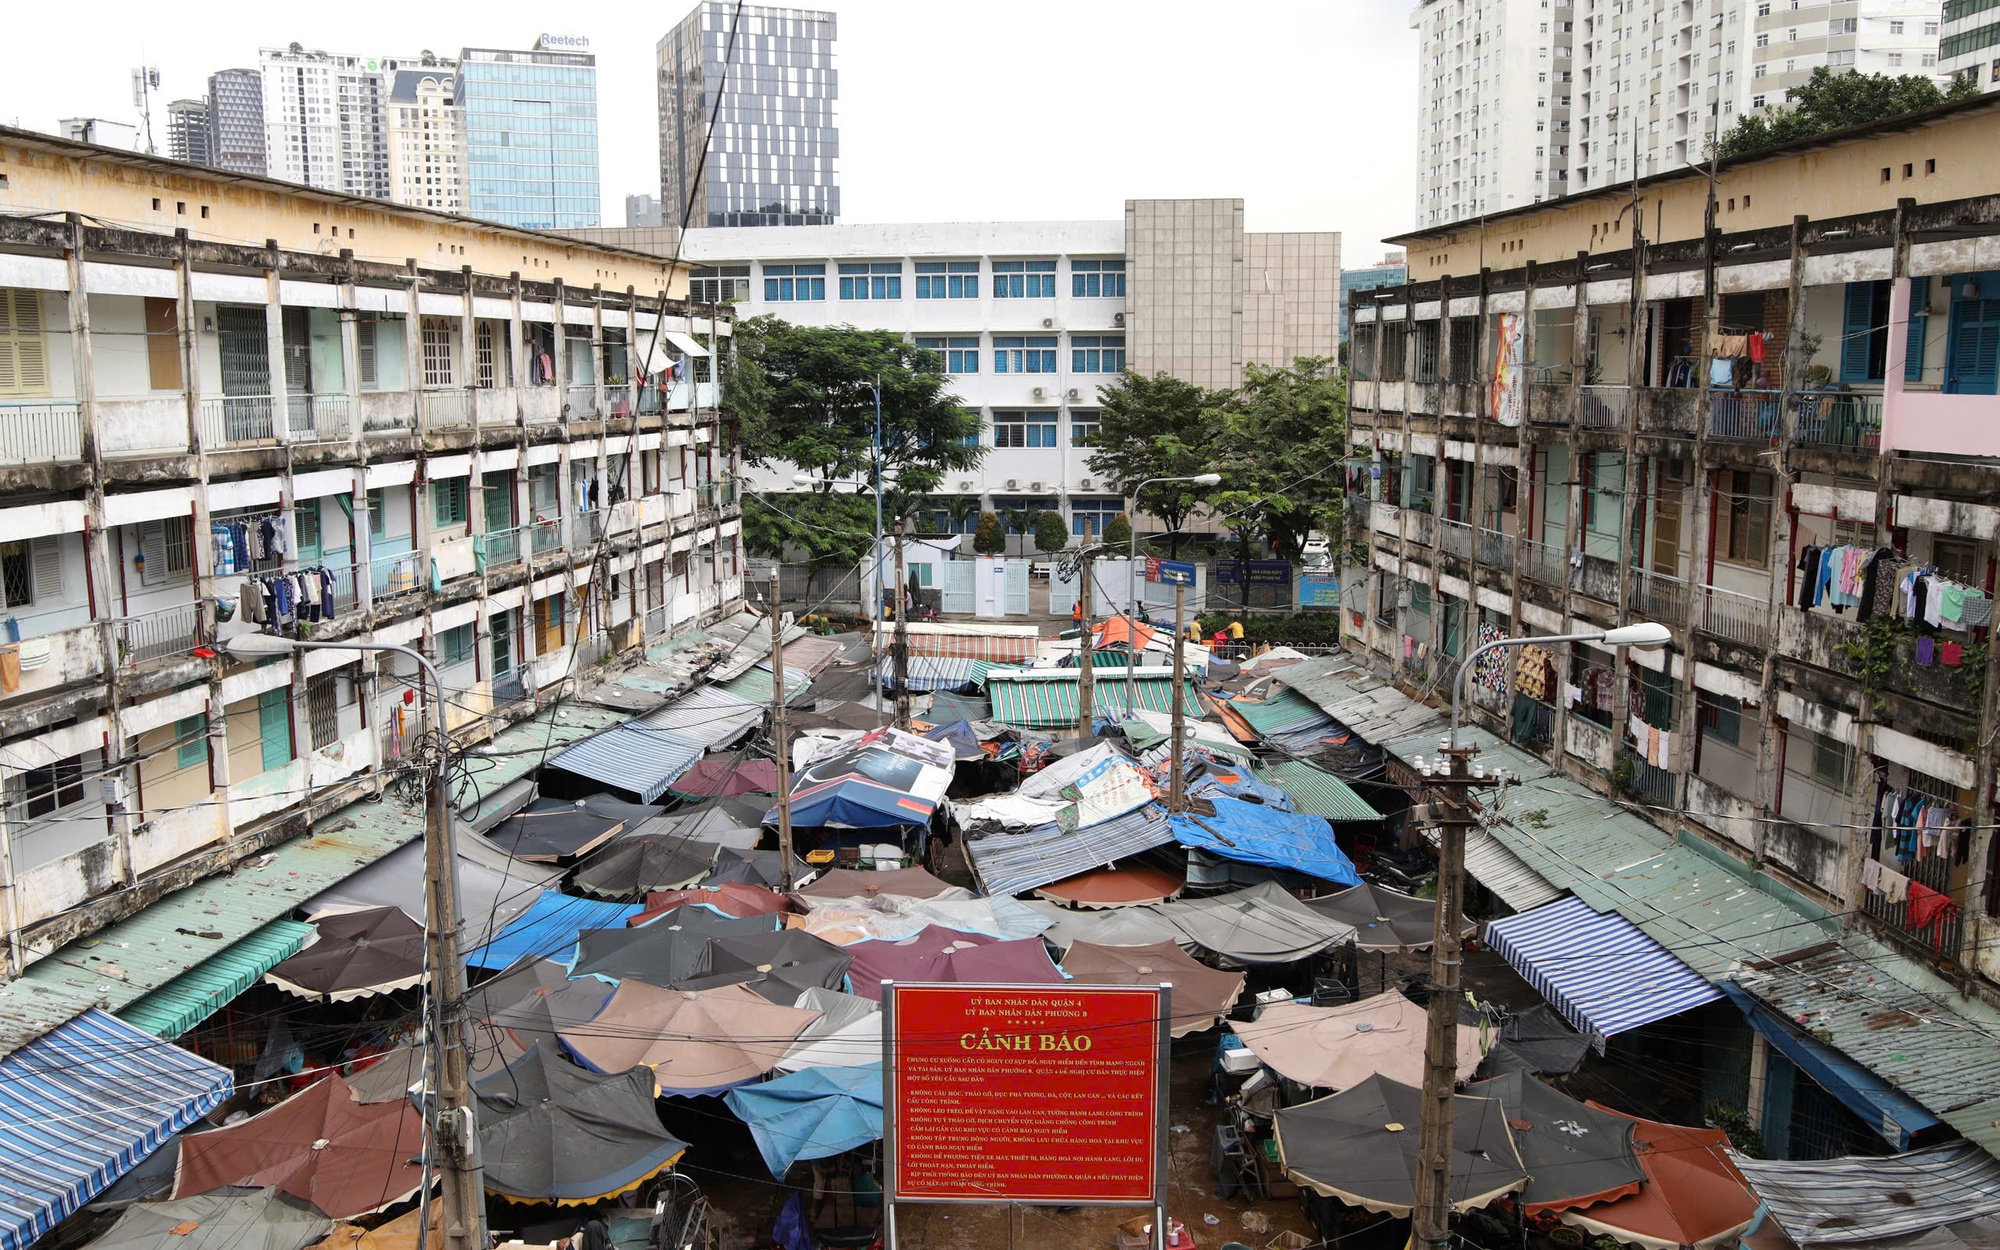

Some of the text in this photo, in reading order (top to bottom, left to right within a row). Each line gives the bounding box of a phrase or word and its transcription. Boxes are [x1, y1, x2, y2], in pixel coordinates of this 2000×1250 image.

[541, 33, 590, 46] Reetech
[971, 997, 983, 1005] UỶ
[1004, 997, 1028, 1006] NHÂN
[1031, 998, 1048, 1006] DÂN
[1051, 998, 1075, 1008] QUẬN
[965, 1007, 977, 1016] UỶ
[998, 1008, 1022, 1016] NHÂN
[1025, 1008, 1042, 1017] DÂN
[1045, 1008, 1080, 1017] PHƯỜNG
[960, 1027, 1092, 1051] CẢNH BÁO
[907, 1074, 920, 1082] MỘT
[987, 1108, 1005, 1116] NẶNG
[934, 1134, 947, 1142] TẬP
[971, 1153, 985, 1161] TIỆN
[1075, 1173, 1092, 1181] QUẬN
